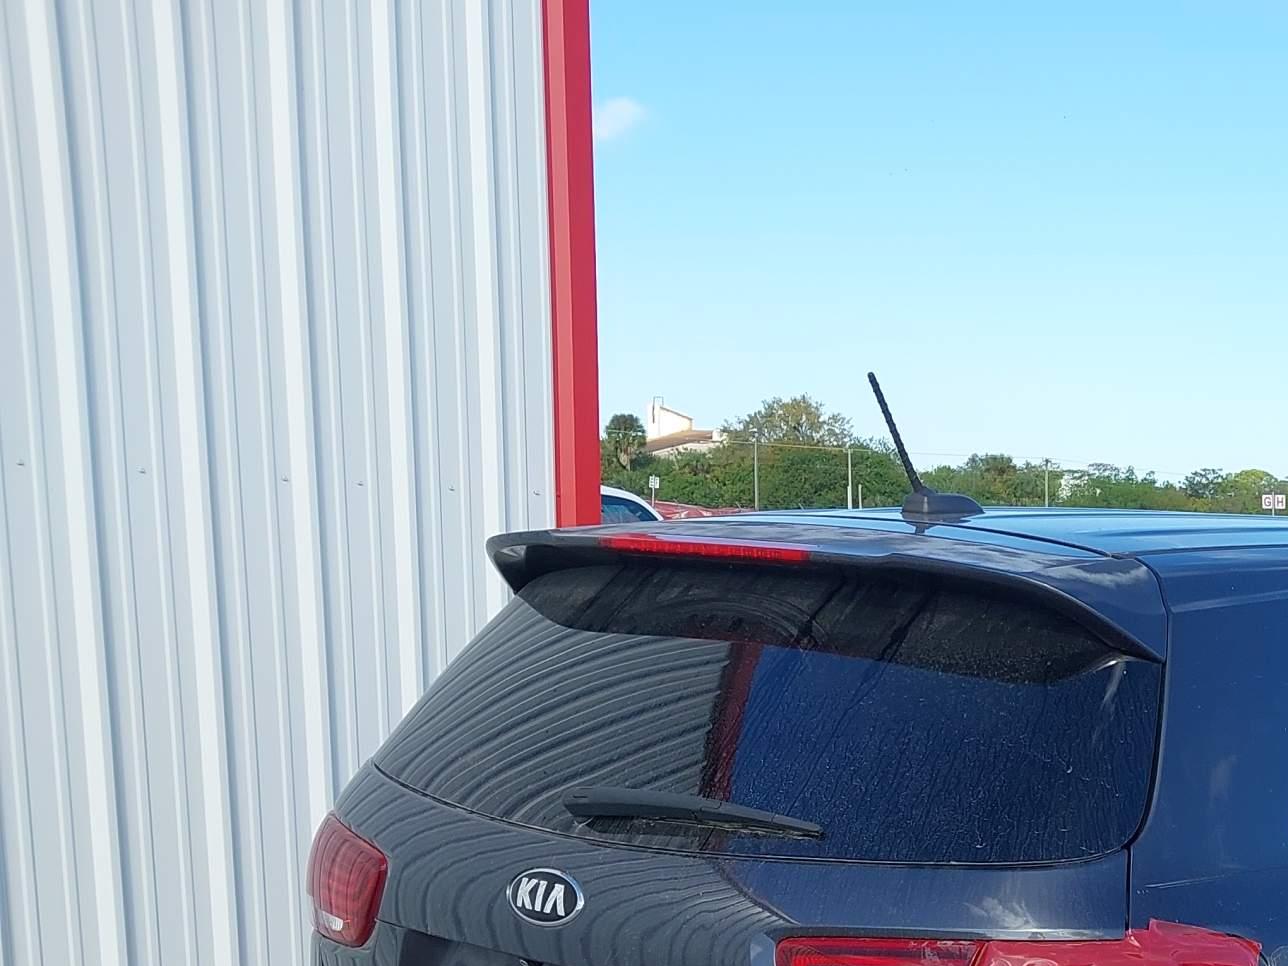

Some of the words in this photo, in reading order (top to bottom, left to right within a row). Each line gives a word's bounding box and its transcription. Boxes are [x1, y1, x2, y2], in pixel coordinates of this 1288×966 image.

[1263, 496, 1272, 507] G
[1276, 496, 1284, 508] H
[516, 876, 566, 917] KIA
